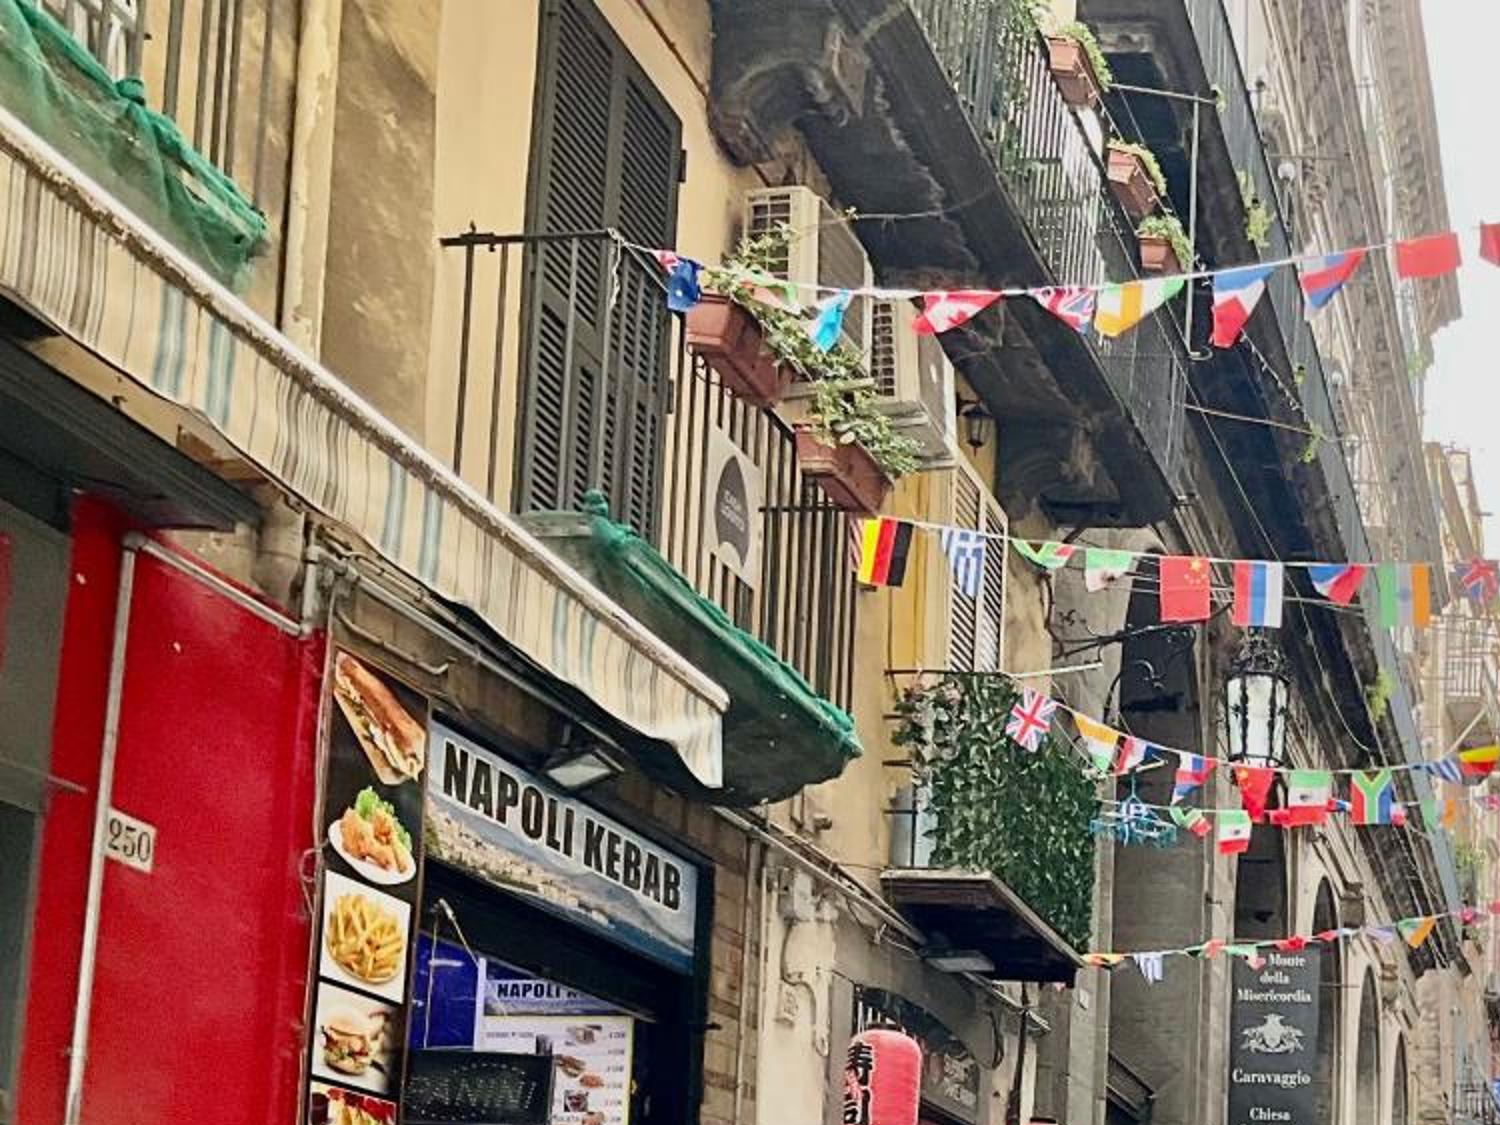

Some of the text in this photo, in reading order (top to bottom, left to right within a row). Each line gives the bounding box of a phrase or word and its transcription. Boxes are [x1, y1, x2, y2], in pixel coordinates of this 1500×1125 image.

[443, 741, 682, 911] NAPOLI KEBAB
[108, 817, 151, 863] 250
[1269, 953, 1306, 967] Monte
[1259, 972, 1290, 984] della
[497, 982, 561, 999] NAPOLI
[1237, 989, 1312, 1003] Misericordia
[1232, 1068, 1312, 1089] Caravaggio
[1250, 1107, 1291, 1121] Chiesa
